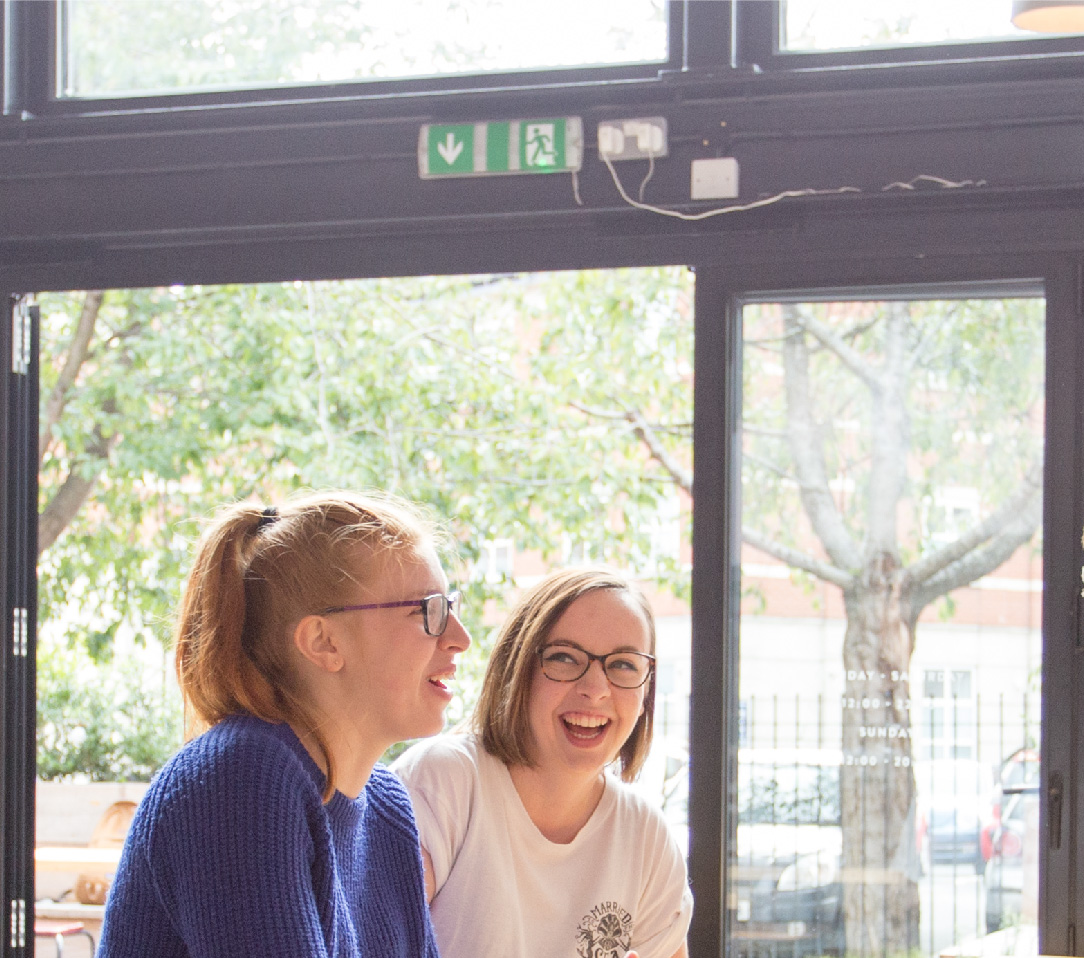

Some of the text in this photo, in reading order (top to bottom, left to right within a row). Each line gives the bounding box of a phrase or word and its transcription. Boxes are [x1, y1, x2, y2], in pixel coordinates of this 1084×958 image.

[890, 670, 964, 682] SARDAY
[859, 726, 914, 739] SUNDAY
[590, 901, 632, 924] MARRIED
